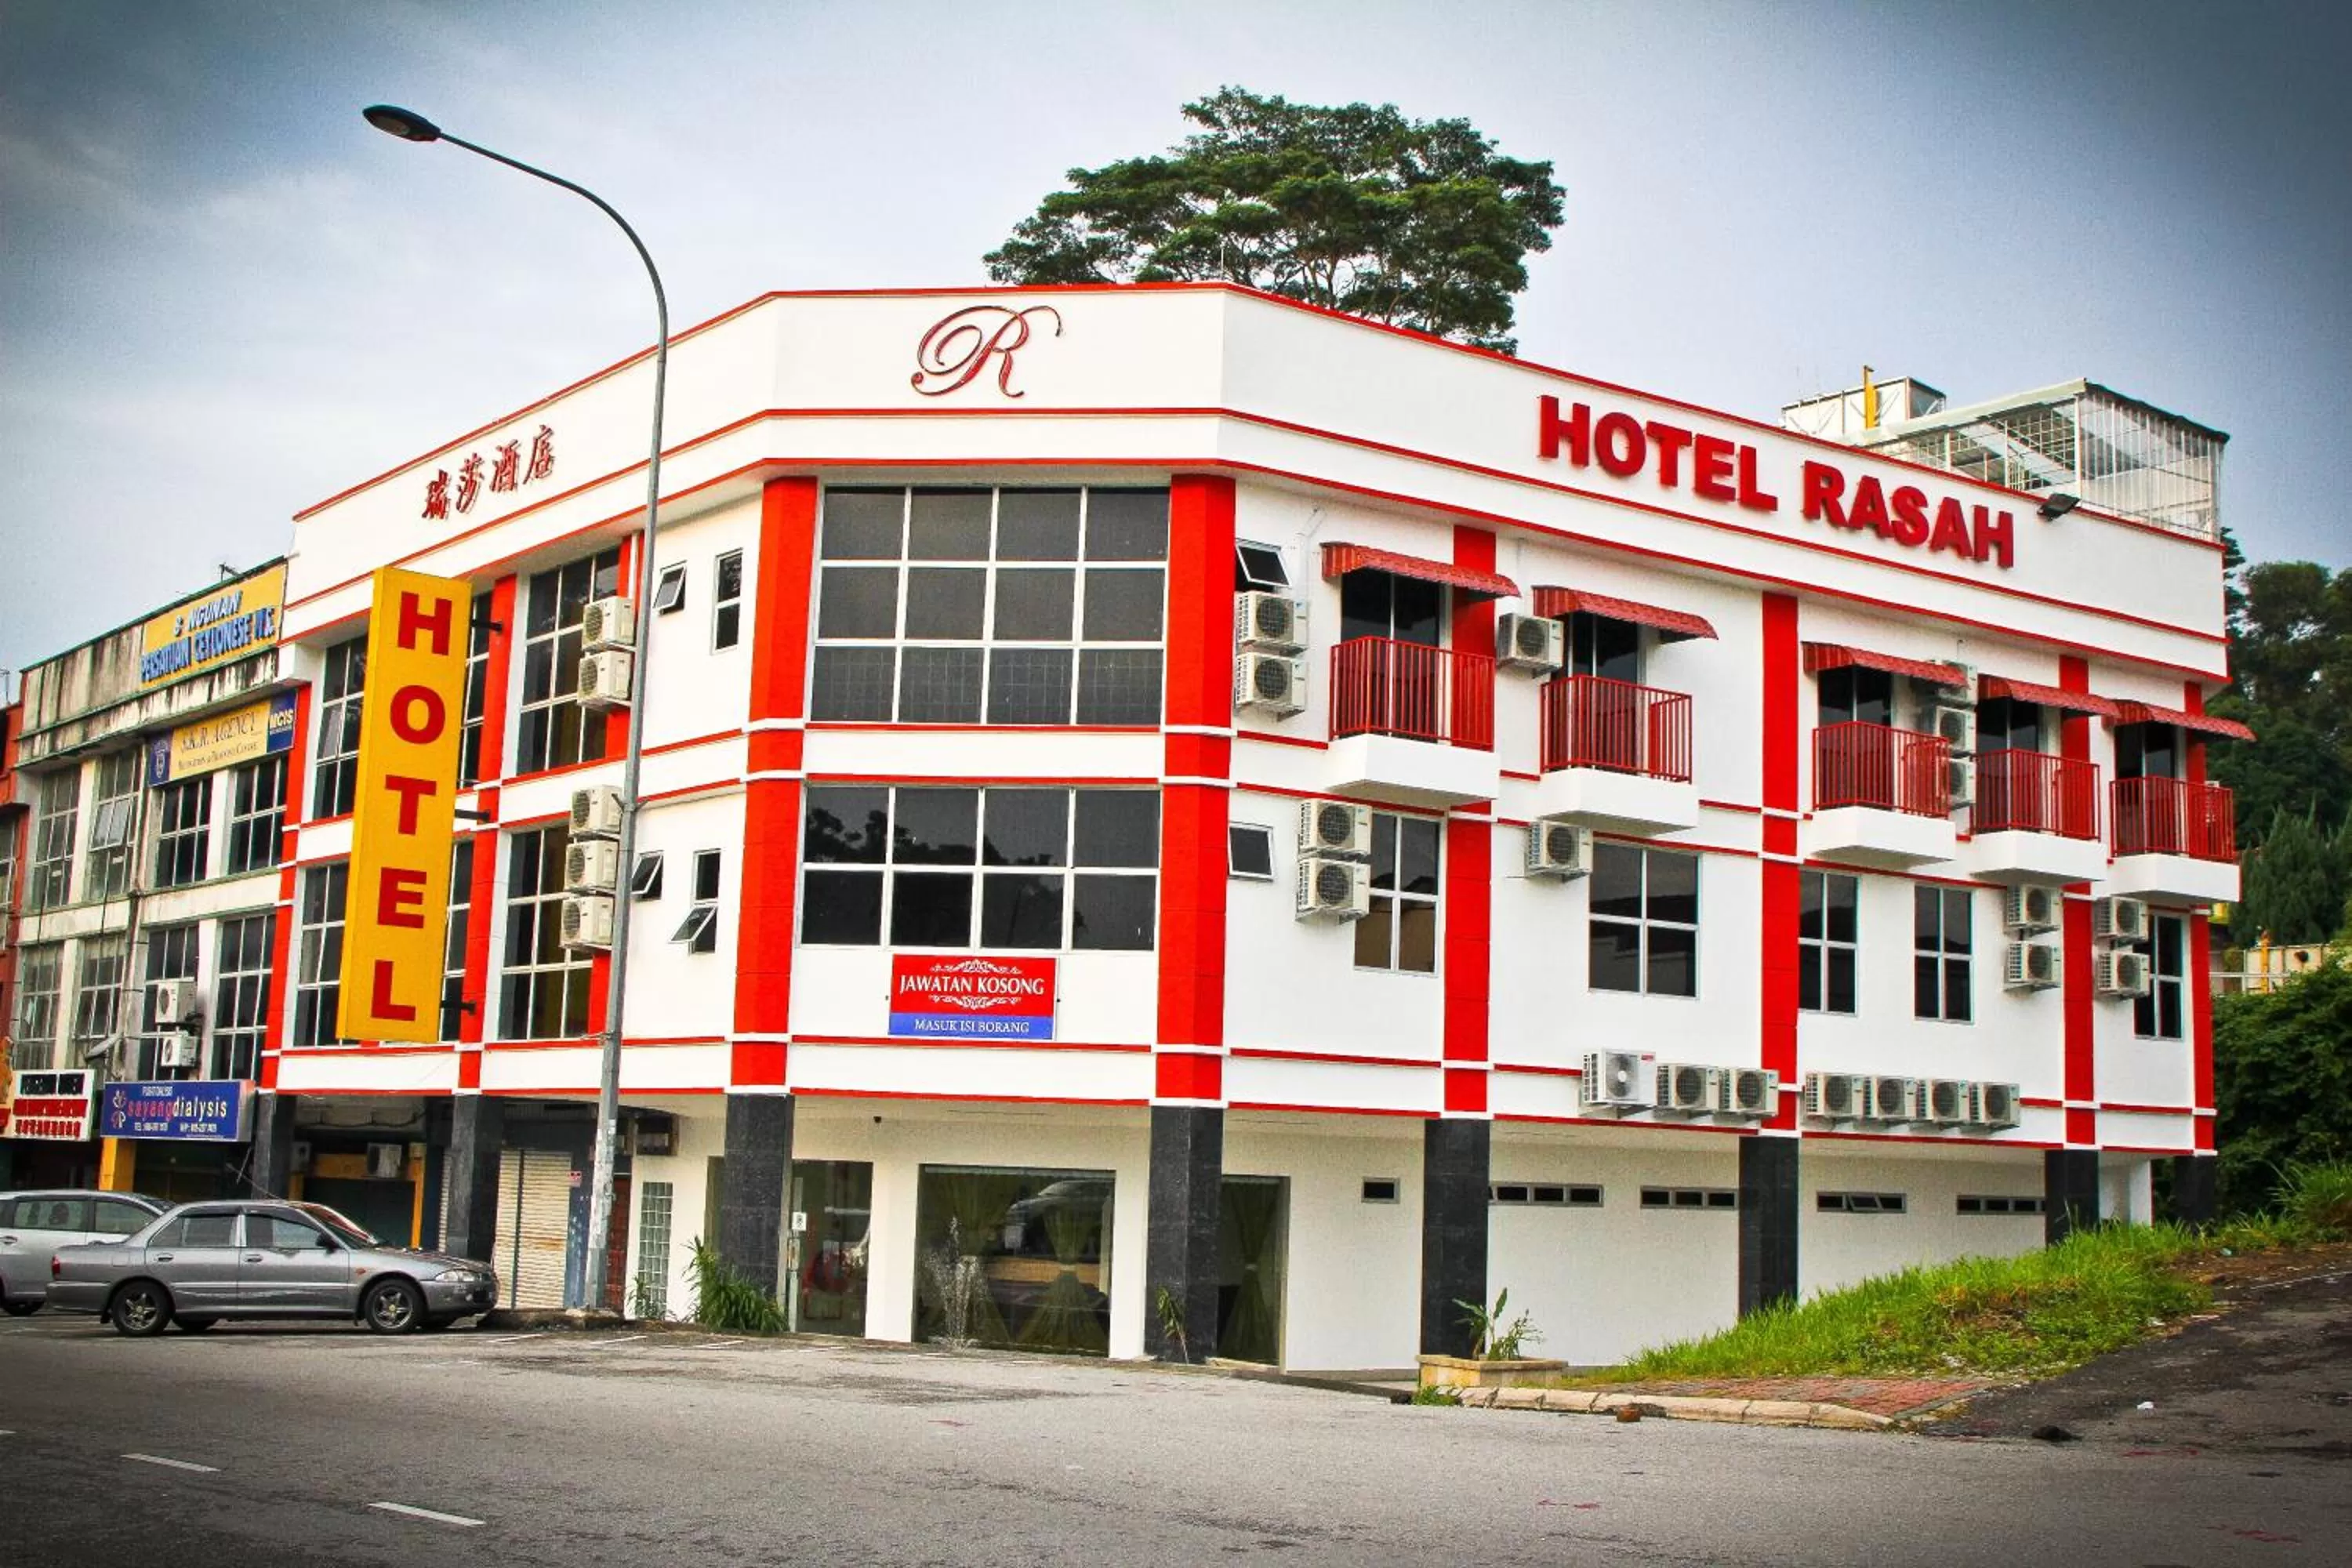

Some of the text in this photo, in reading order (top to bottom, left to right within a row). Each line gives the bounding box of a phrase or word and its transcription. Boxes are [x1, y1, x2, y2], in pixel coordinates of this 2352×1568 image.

[911, 305, 1062, 397] R
[1537, 394, 2015, 568] HOTEL RASAH
[141, 637, 191, 682] PERSATUAN
[194, 613, 252, 663] CEYLONESE
[370, 590, 452, 1022] HOTEL
[899, 975, 1044, 995] JAWATAN KOSONG
[914, 1018, 1029, 1033] MASUK ISI BORANG
